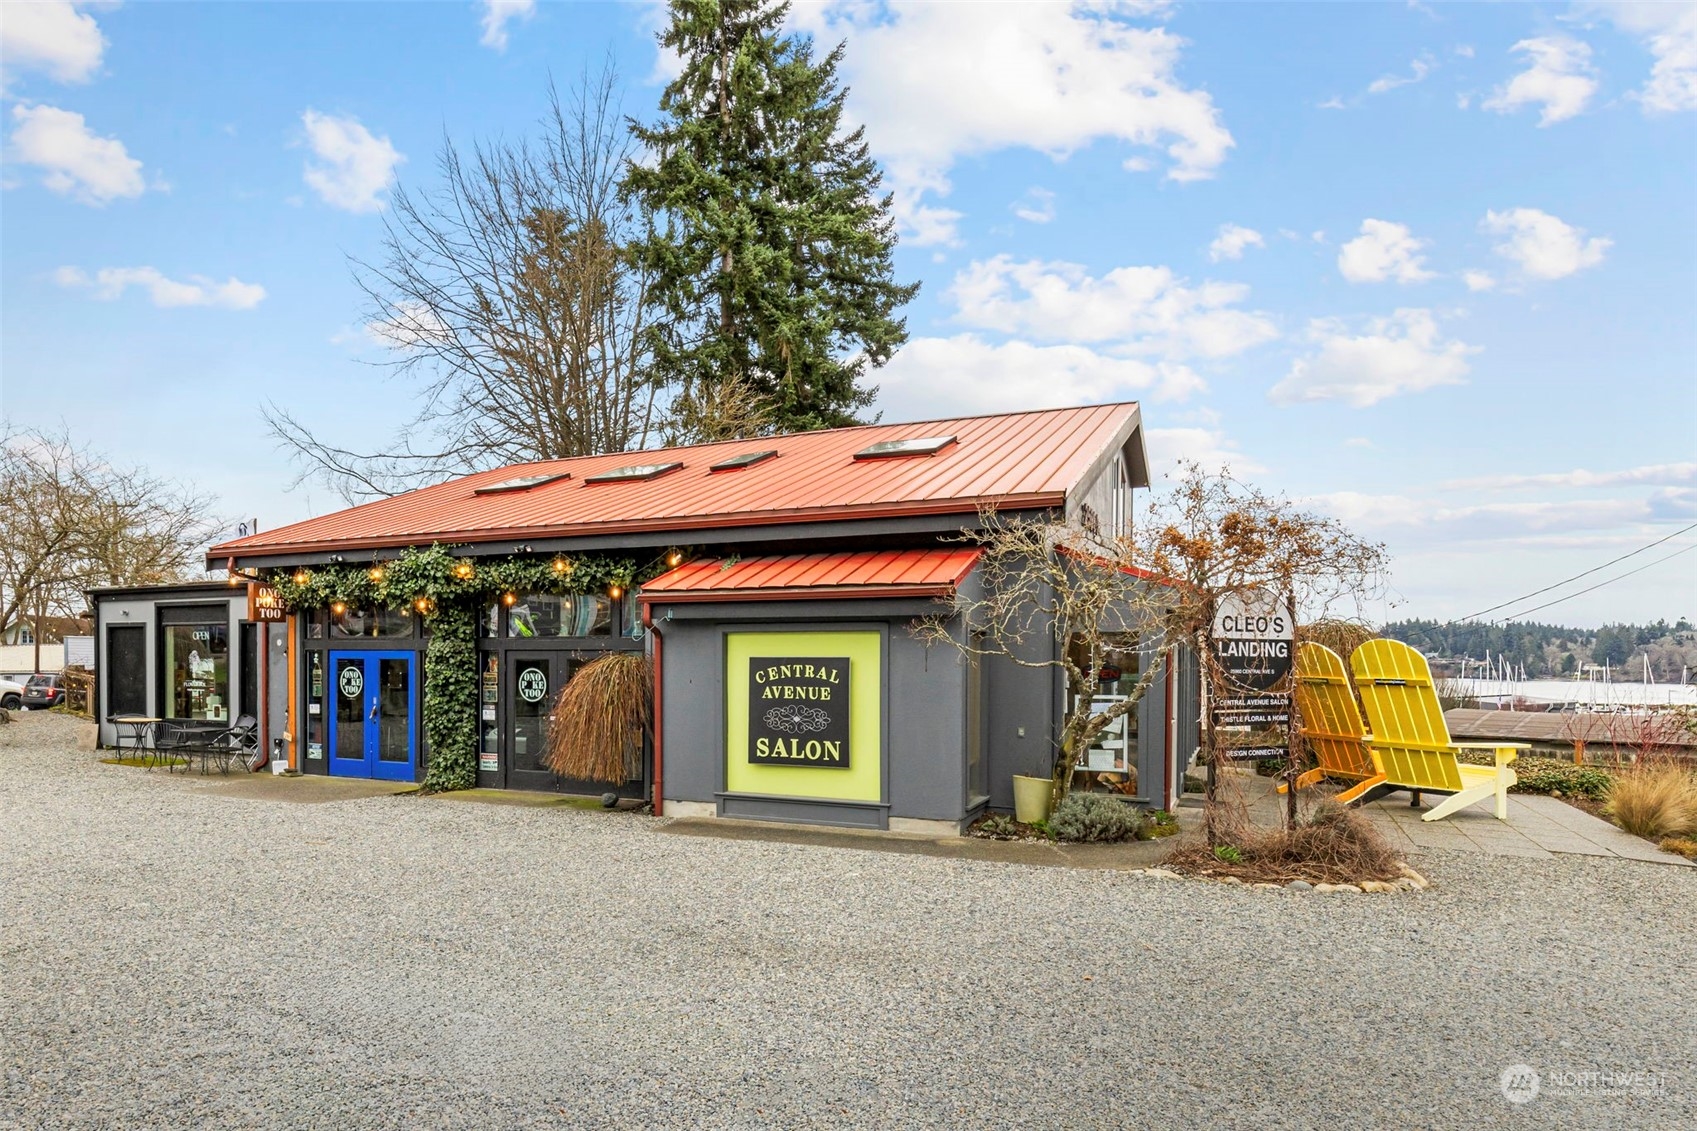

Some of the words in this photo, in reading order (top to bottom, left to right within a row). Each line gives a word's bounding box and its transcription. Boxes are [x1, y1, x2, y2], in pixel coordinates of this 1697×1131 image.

[255, 597, 285, 608] POKE
[259, 608, 281, 619] TOO
[1222, 615, 1285, 634] CLEO'S
[192, 631, 210, 640] OPEN
[1218, 641, 1288, 658] LANDING
[524, 673, 541, 681] ONO
[755, 664, 840, 684] CENTRAL
[524, 689, 541, 697] TOO
[761, 685, 831, 701] AVENUE
[756, 737, 841, 761] SALON
